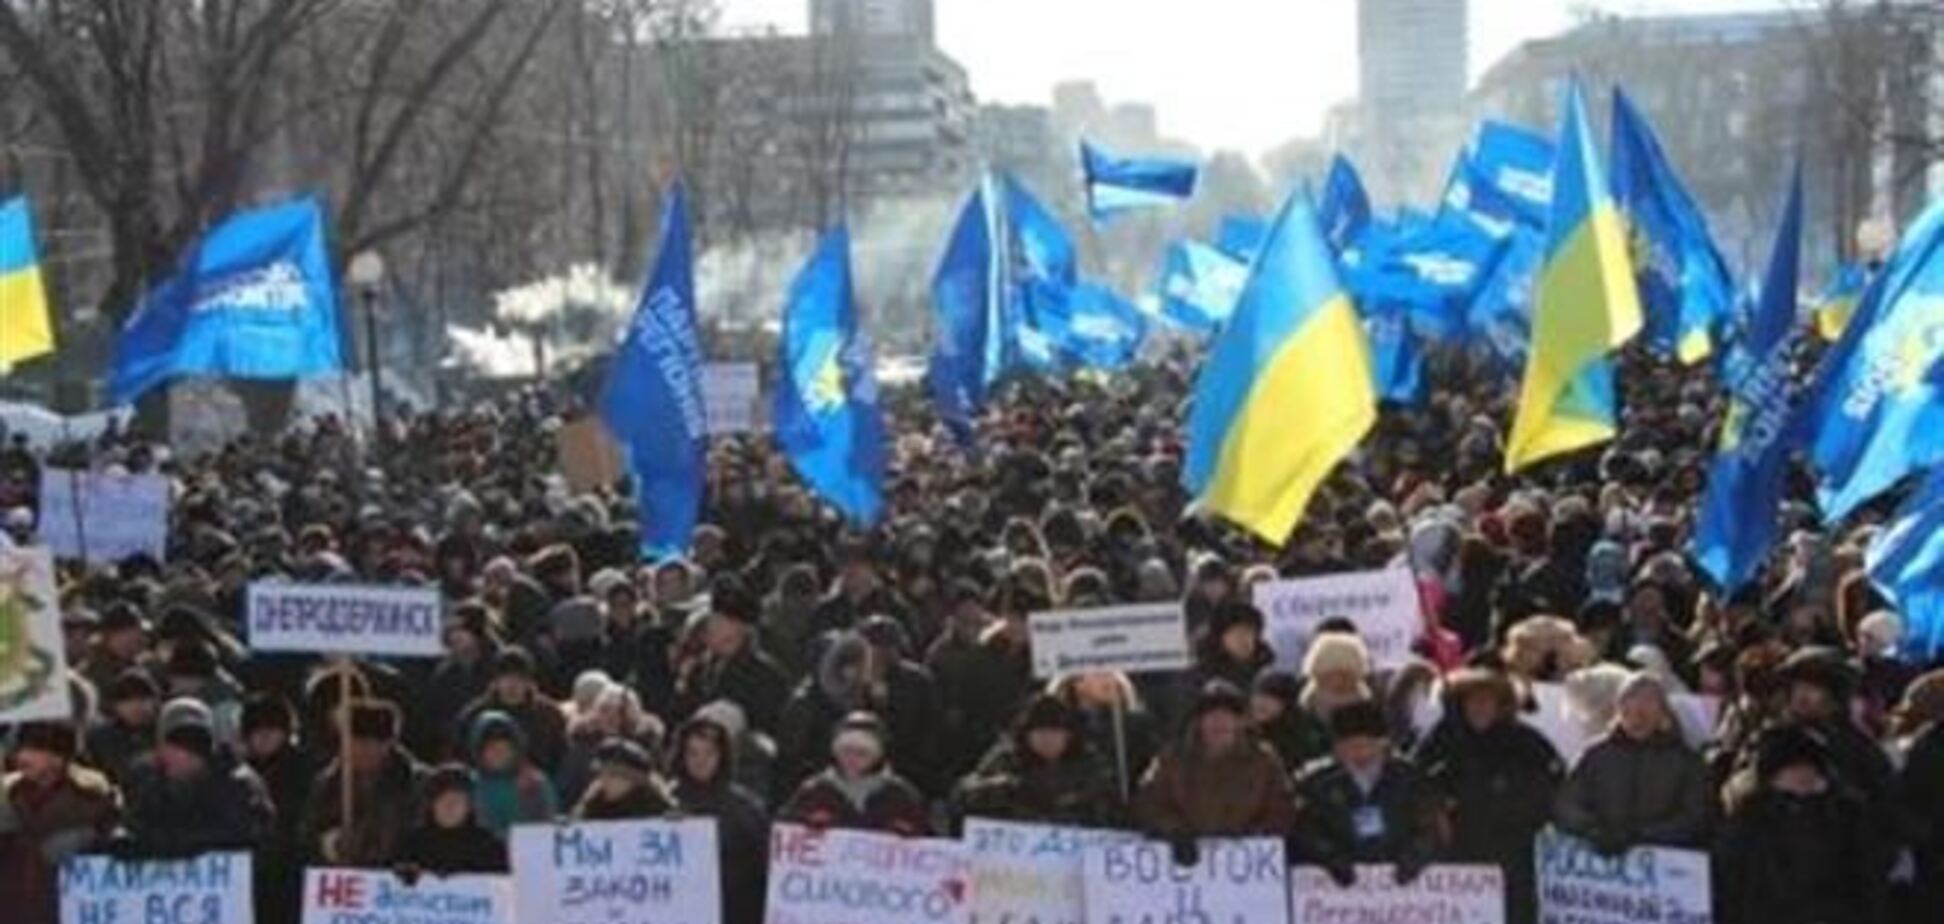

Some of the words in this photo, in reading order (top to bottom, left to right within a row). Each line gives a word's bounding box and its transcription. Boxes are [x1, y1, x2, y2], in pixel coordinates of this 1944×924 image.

[771, 830, 826, 867] НЕ
[144, 892, 222, 924] ВСЯ
[318, 873, 366, 908] НЕ
